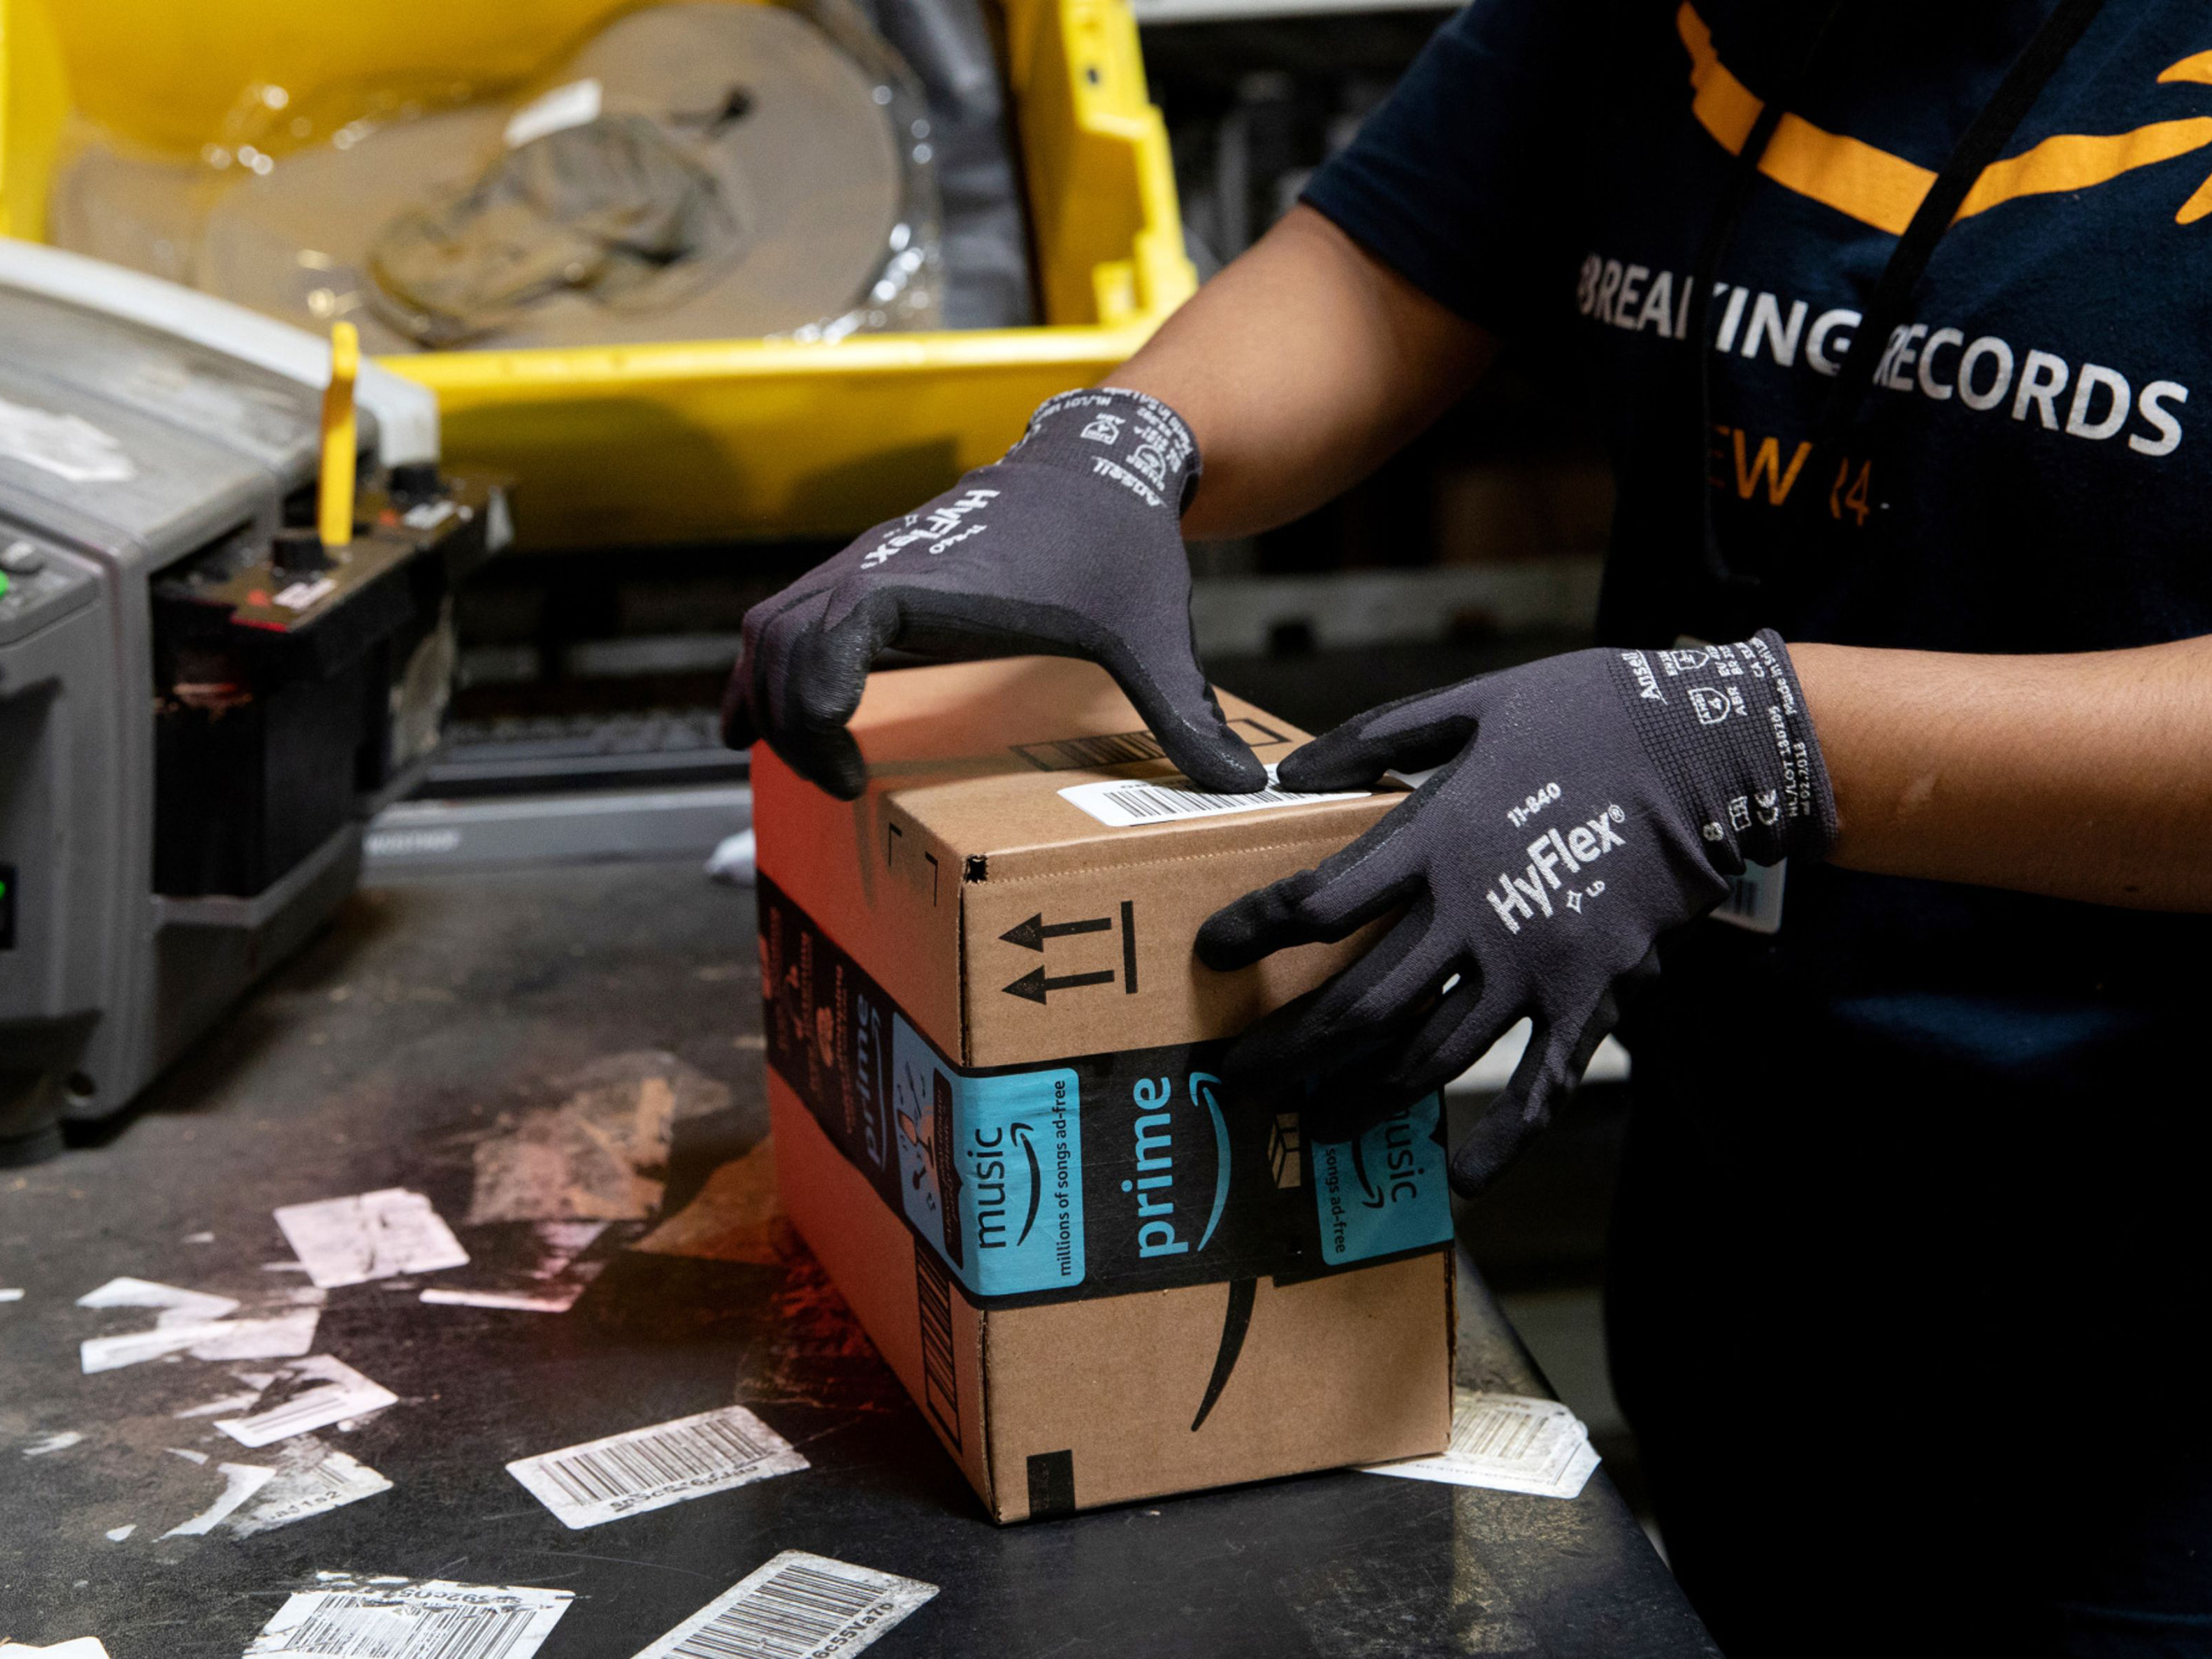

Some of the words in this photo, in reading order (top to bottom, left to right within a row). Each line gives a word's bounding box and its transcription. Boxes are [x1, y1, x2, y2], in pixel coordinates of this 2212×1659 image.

[1872, 324, 2188, 456] RECORDS
[1621, 650, 1666, 703] Ansell
[1727, 686, 1747, 716] ABR
[857, 994, 881, 1166] prime
[1051, 1080, 1068, 1139] ad-free
[967, 1127, 1006, 1248] music
[1055, 1142, 1071, 1189] songs
[1121, 1077, 1189, 1257] prime
[1325, 1147, 1340, 1194] songs
[1055, 1192, 1069, 1208] of
[1331, 1196, 1346, 1254] ad-free
[1055, 1212, 1072, 1276] millions
